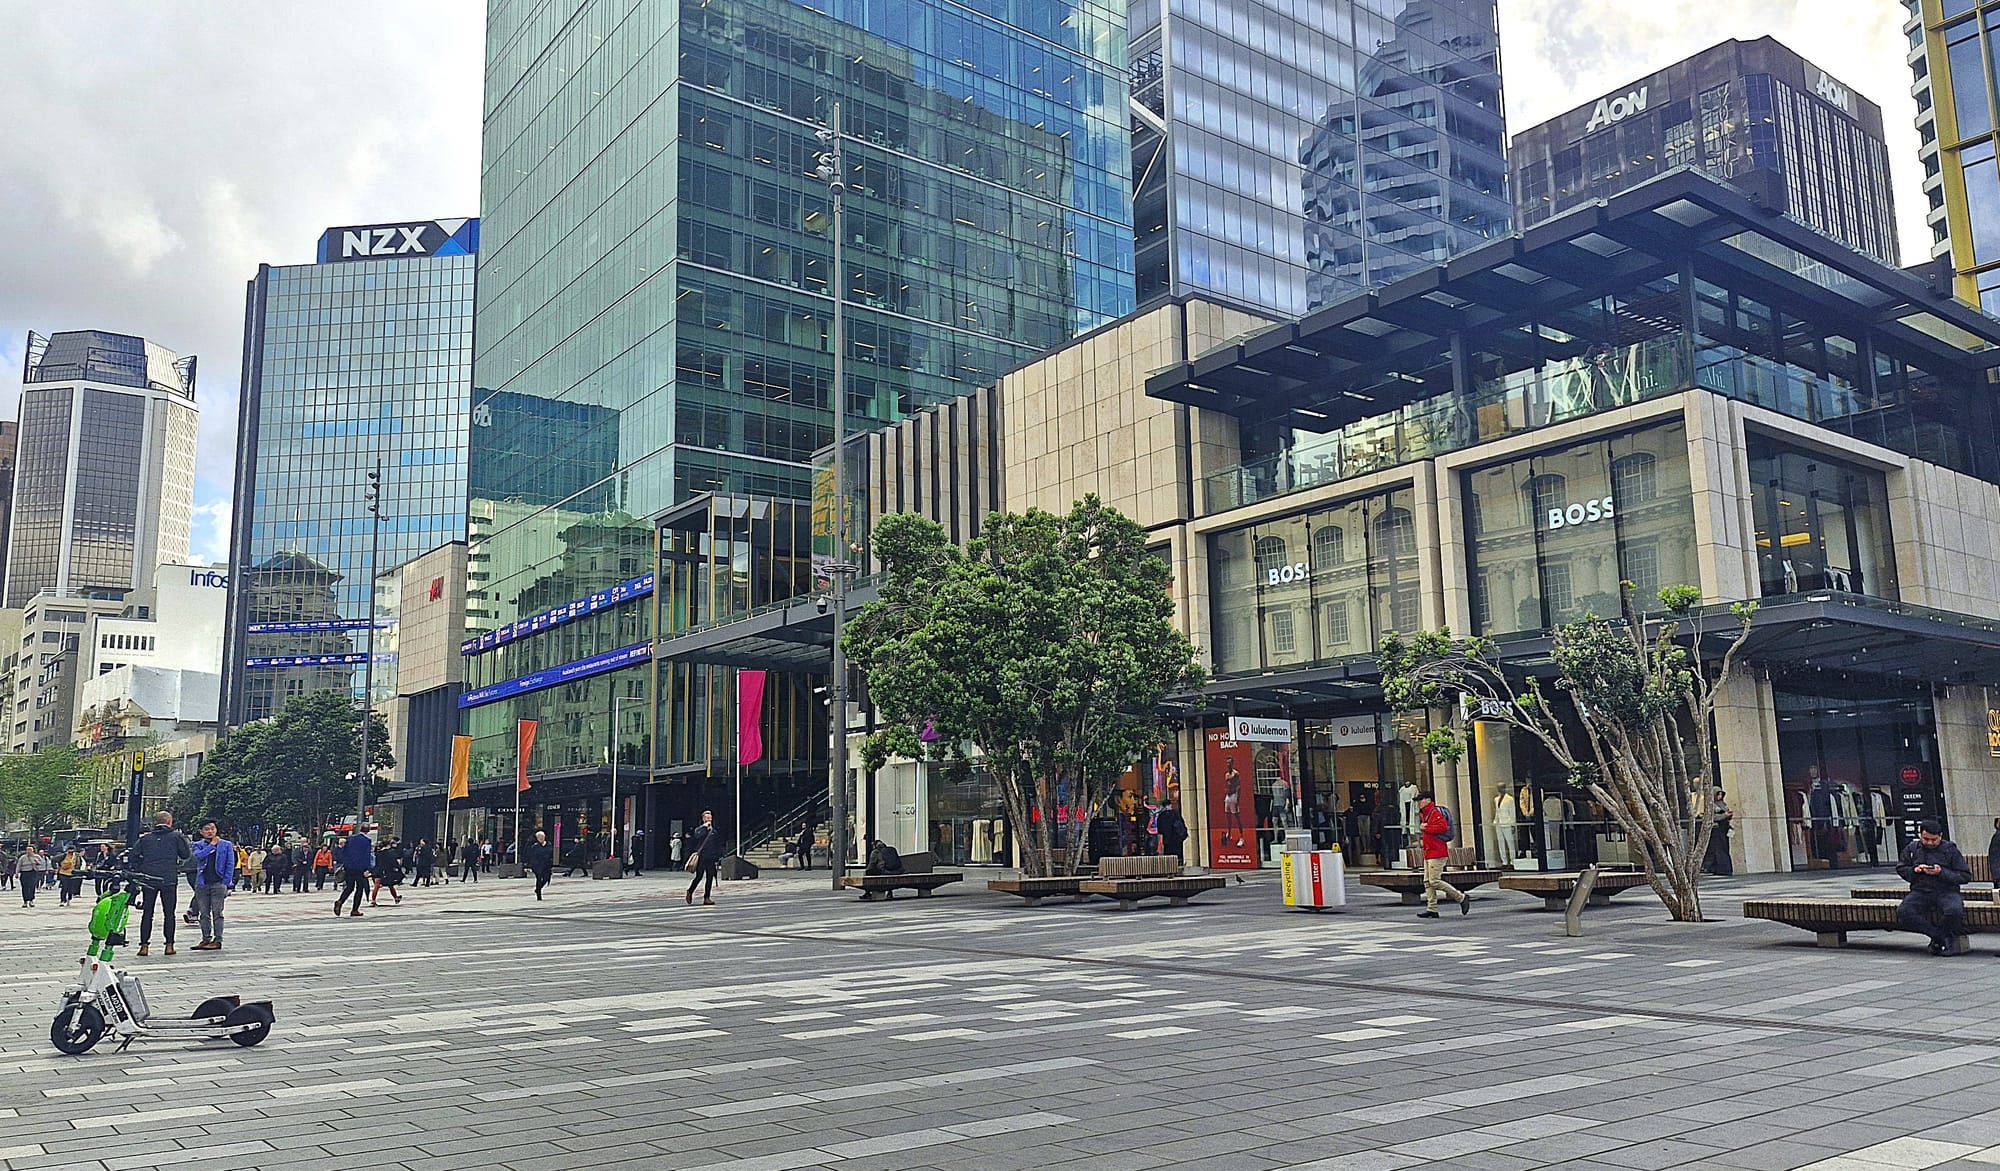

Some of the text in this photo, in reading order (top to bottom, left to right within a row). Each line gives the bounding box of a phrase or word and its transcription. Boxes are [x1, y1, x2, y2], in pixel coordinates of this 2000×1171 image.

[1816, 71, 1849, 112] AON
[1585, 86, 1648, 133] AON
[342, 226, 427, 257] NZX
[1548, 495, 1615, 530] BOSS
[1220, 741, 1239, 749] BACK
[1251, 724, 1288, 736] lululemon
[1284, 862, 1292, 898] Recycling
[1312, 862, 1320, 883] Litter
